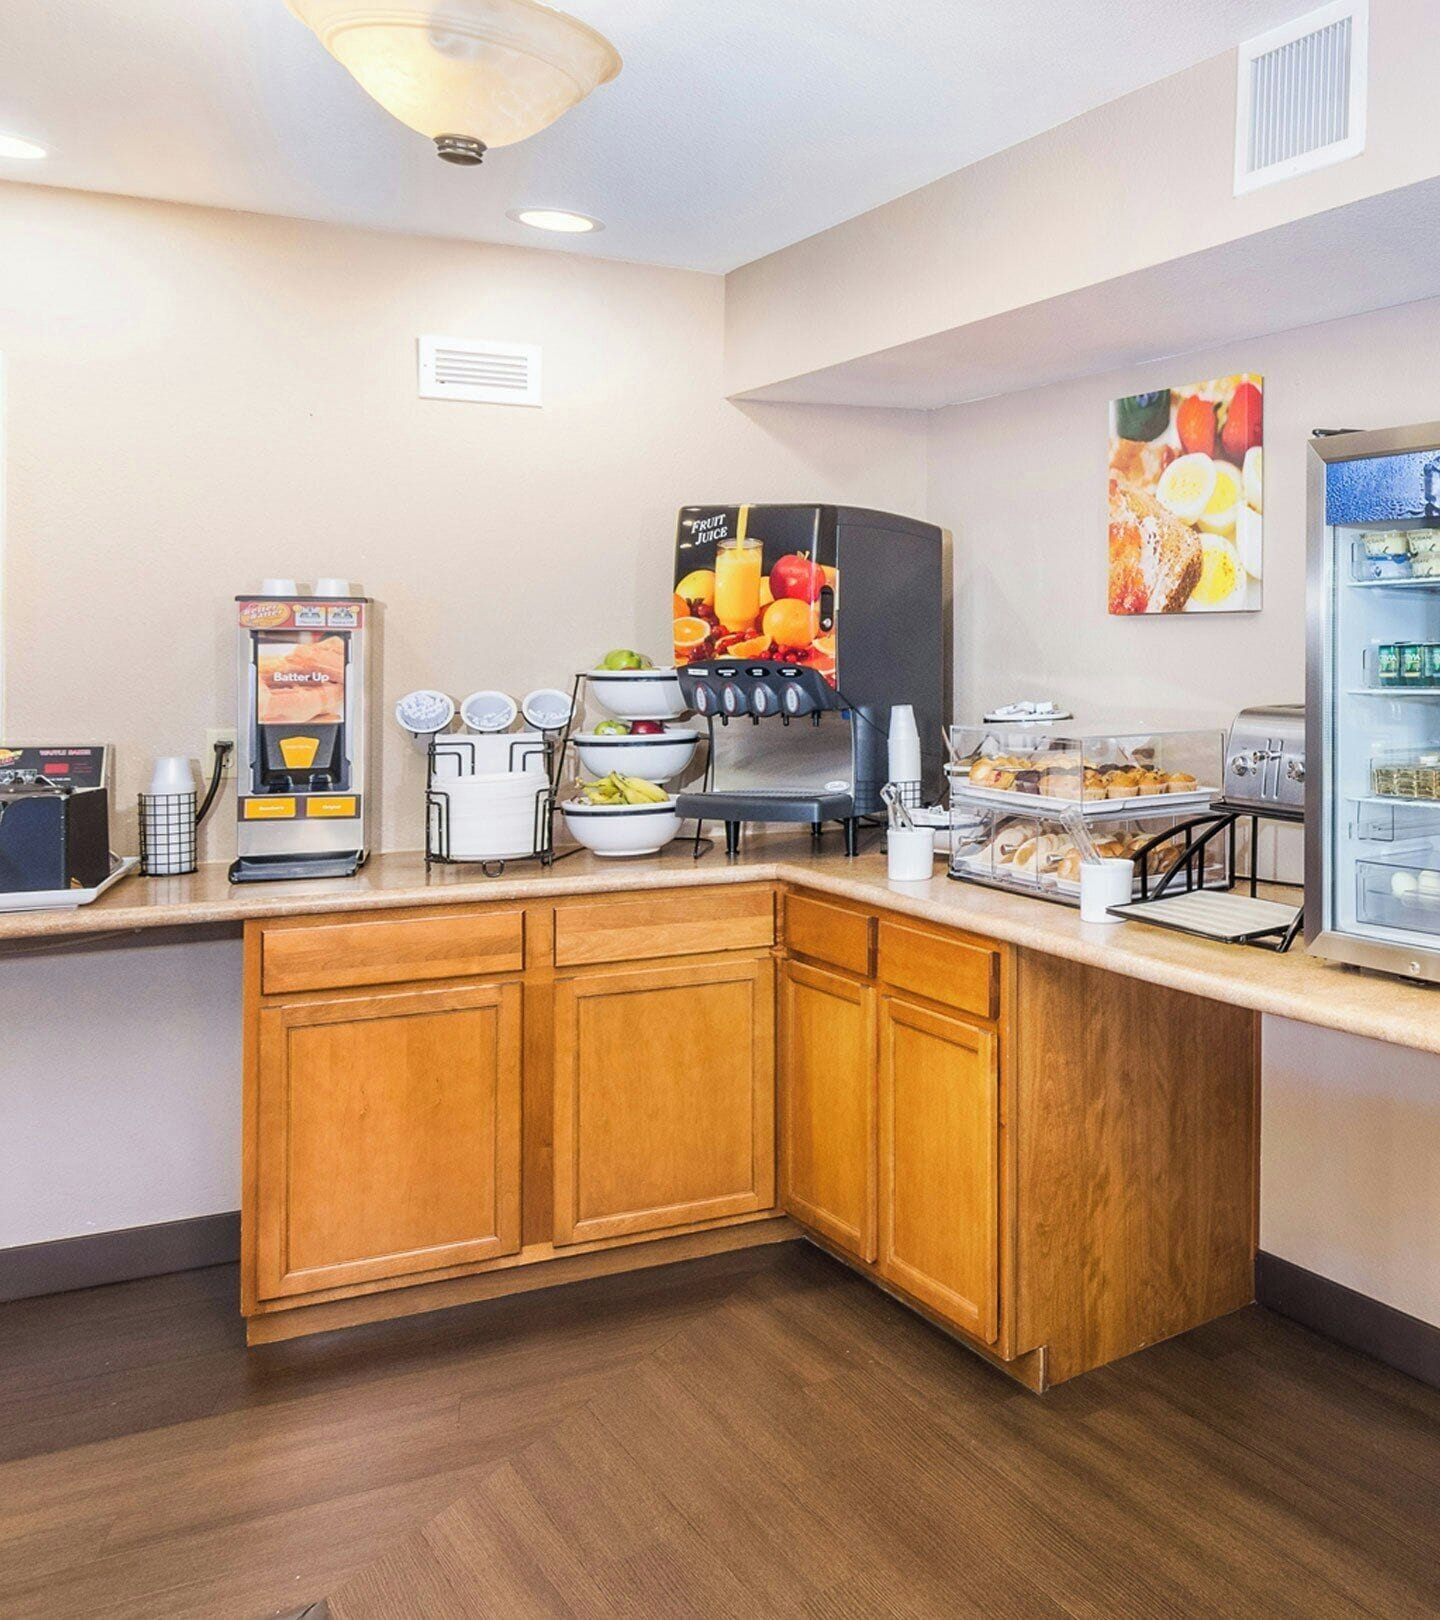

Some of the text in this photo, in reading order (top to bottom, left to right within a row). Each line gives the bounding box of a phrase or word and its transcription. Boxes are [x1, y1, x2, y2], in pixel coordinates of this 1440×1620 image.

[691, 514, 726, 534] FRUIT
[695, 526, 728, 546] JUICE
[273, 672, 329, 683] Batter Up
